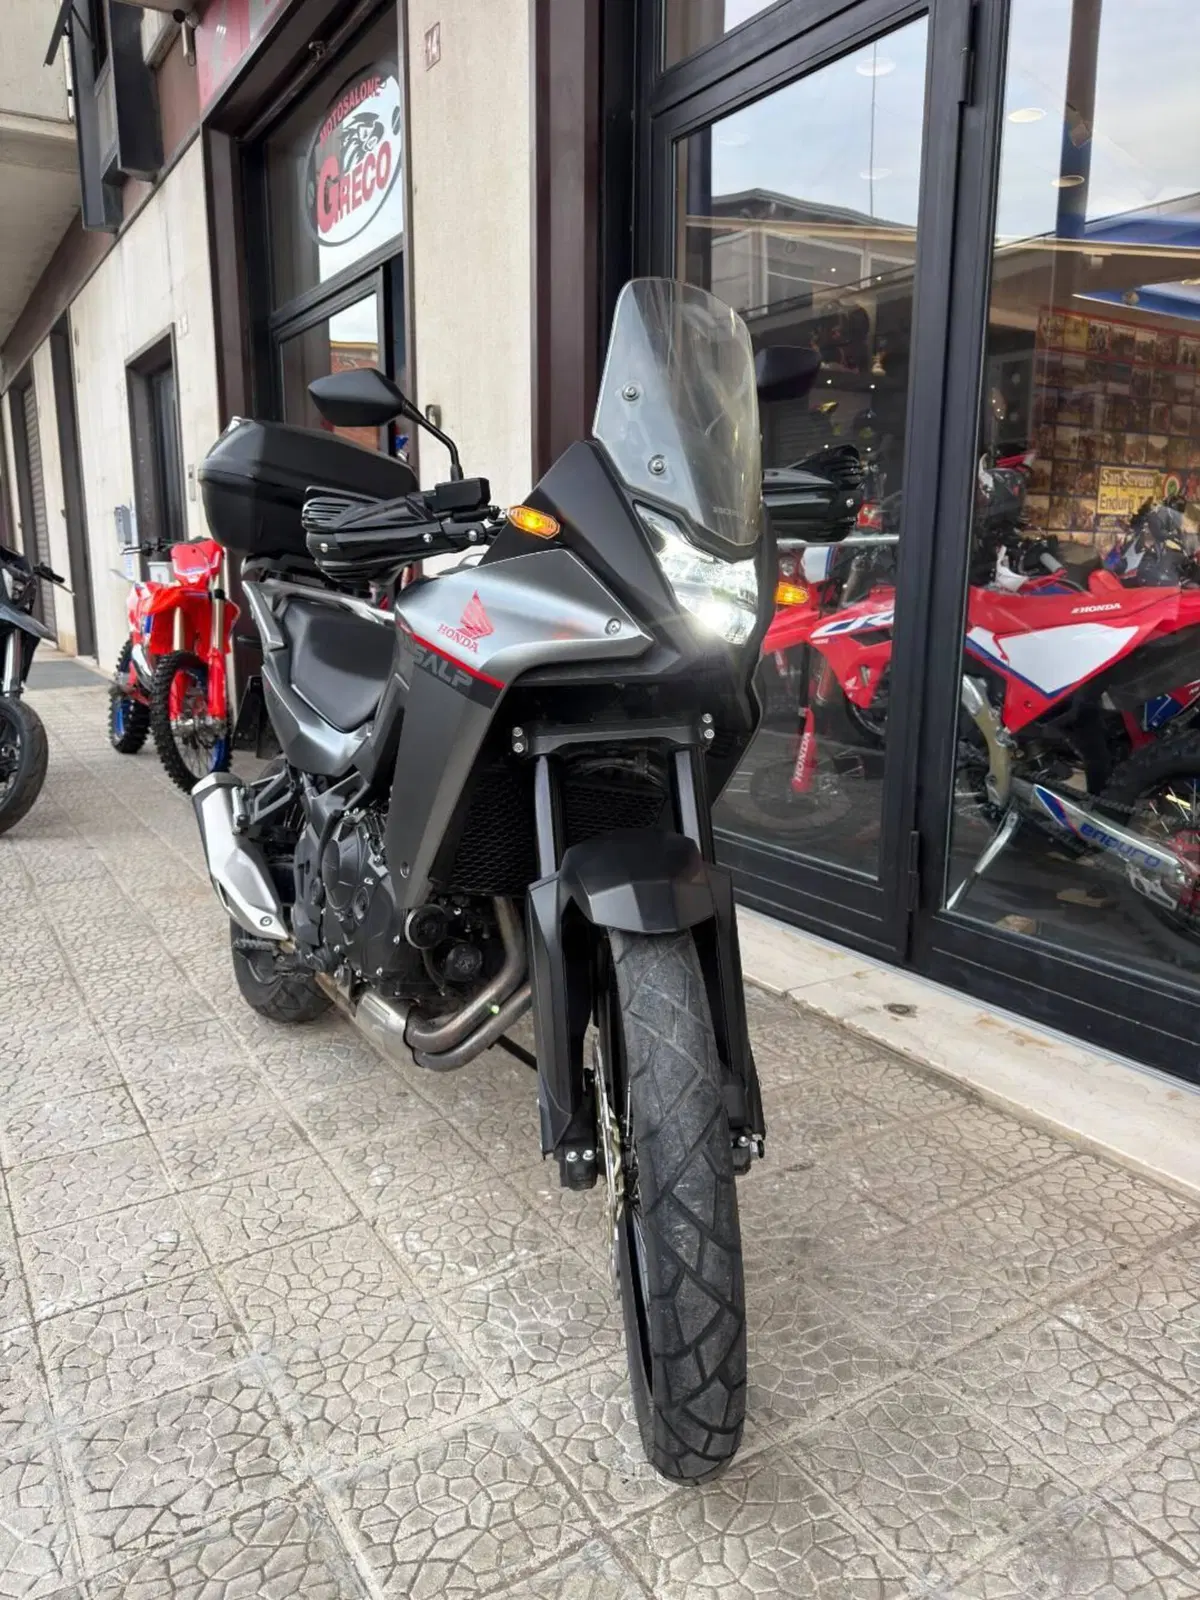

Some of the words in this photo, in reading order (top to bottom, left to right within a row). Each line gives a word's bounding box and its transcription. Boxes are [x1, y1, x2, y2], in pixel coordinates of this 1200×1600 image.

[319, 76, 382, 147] MOTOSALONE
[317, 140, 392, 234] GRECO
[1079, 602, 1121, 614] HONDA
[437, 623, 479, 653] HONDA
[793, 731, 811, 782] HONDA
